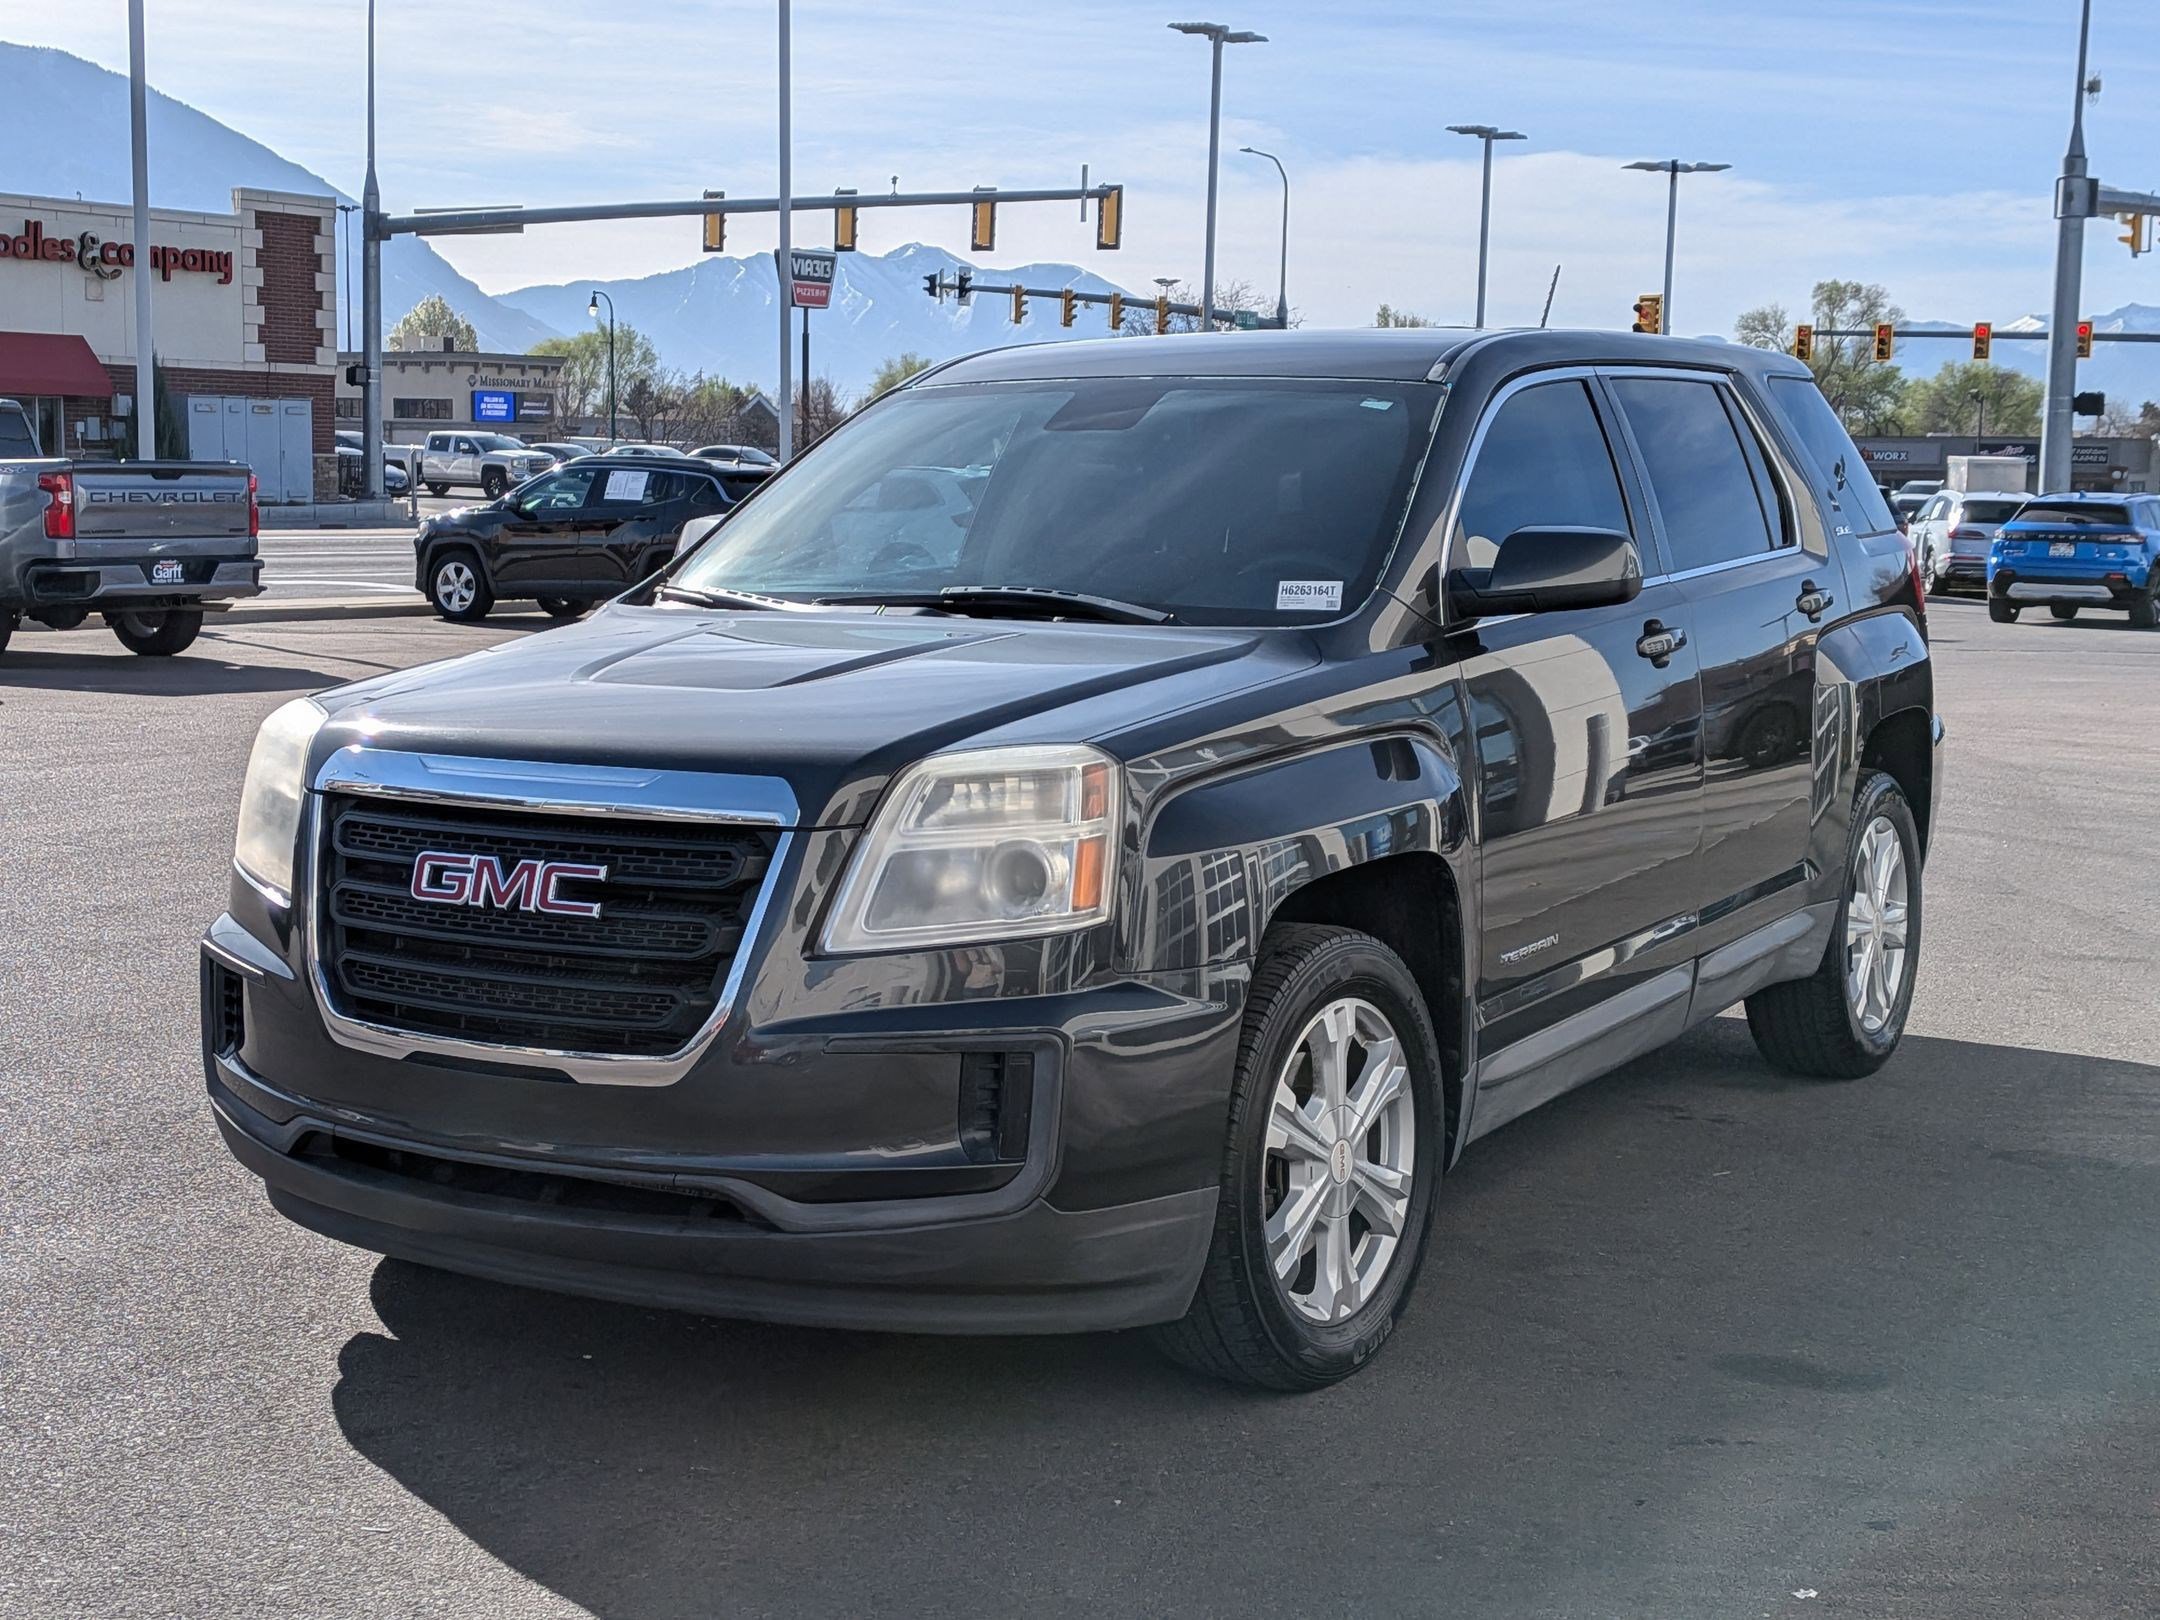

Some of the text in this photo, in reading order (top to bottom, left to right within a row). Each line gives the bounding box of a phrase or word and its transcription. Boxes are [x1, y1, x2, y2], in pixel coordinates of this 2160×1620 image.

[89, 491, 241, 503] CHEVROLET
[1281, 584, 1337, 596] H6263164T
[411, 851, 608, 919] GMC
[1500, 933, 1559, 964] TERRAIN
